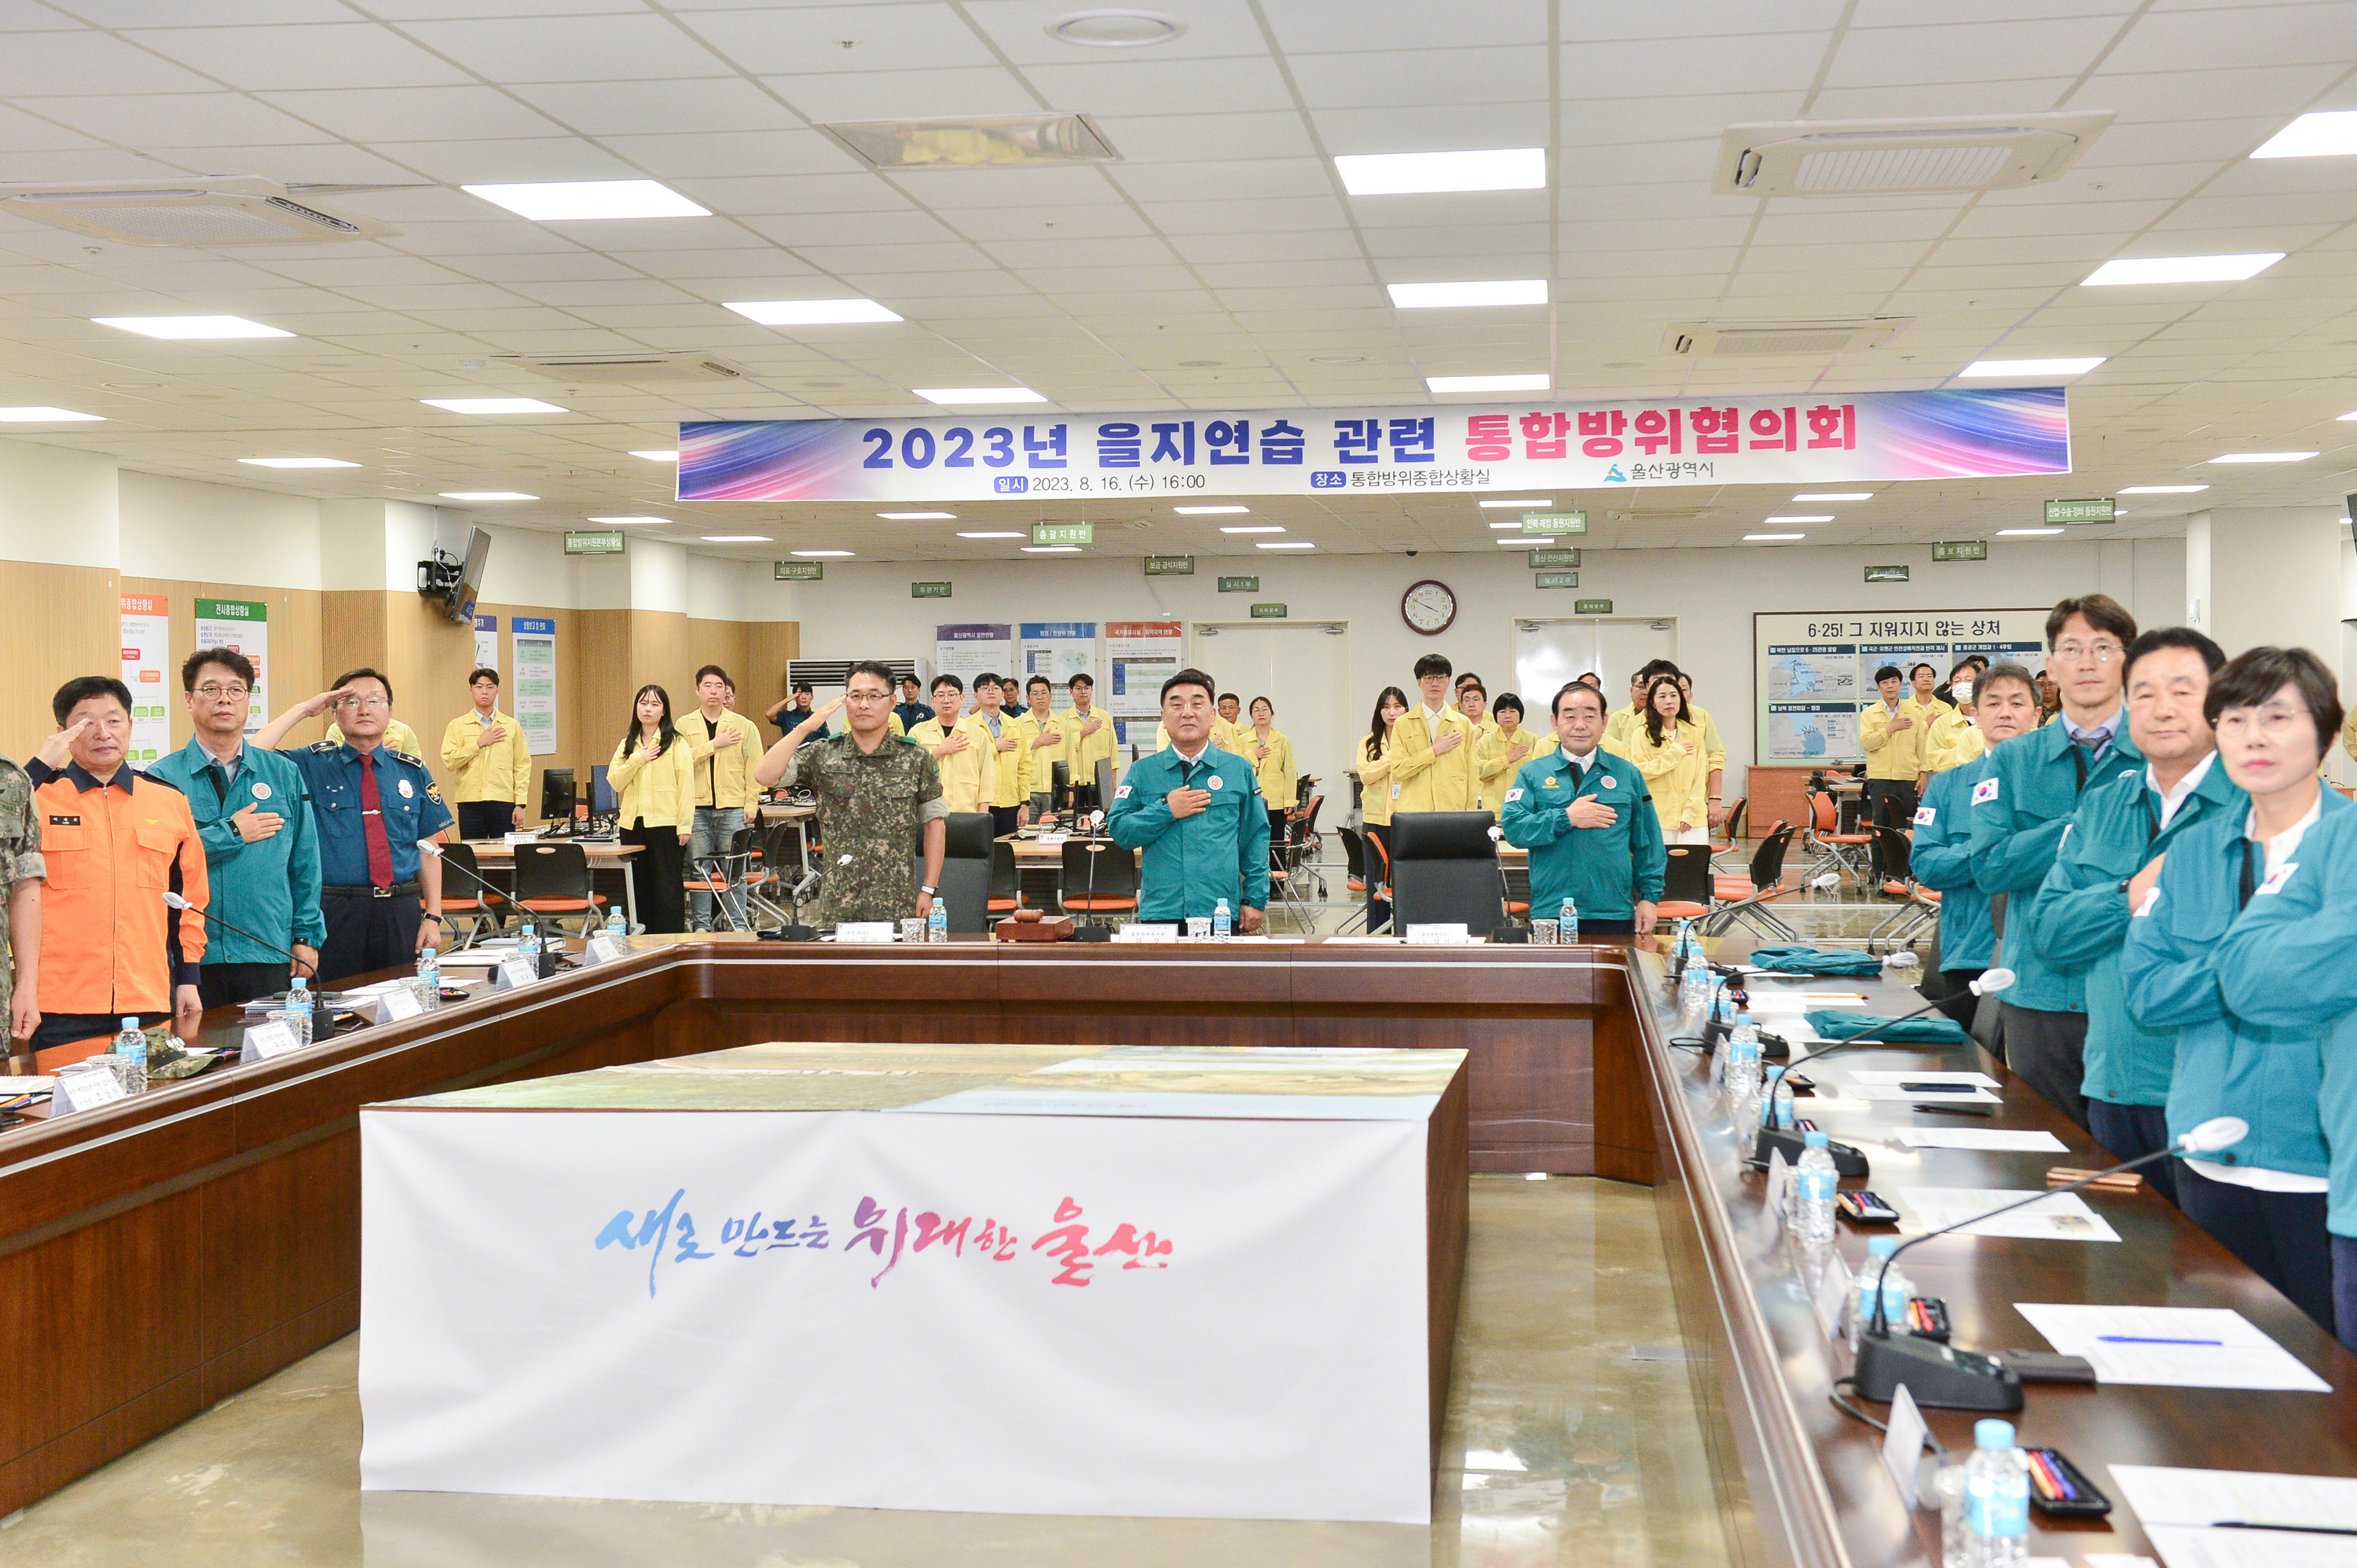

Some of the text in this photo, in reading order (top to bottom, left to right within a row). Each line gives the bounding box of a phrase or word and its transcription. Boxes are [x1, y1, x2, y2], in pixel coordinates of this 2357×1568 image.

[863, 405, 1857, 469] 2023년 을지연습 관련 통합방위협의회
[1315, 467, 1491, 488] 장소 통합방위종합상황실
[1630, 460, 1714, 480] 울산광역시
[998, 474, 1206, 493] 일시 2023. 8. 16. (수) 16:00
[2085, 504, 2112, 516] 동원지원반
[1552, 518, 1582, 528] 동원지원반
[567, 537, 621, 548] 통합방위지원본부상황실
[1039, 529, 1087, 540] 총괄지원반
[215, 603, 249, 617] 전시종합상황실
[1808, 621, 2000, 637] 6·25! 그 지워지지 않는 상처
[595, 1189, 1174, 1300] 새로 만드는 위대한 울산
